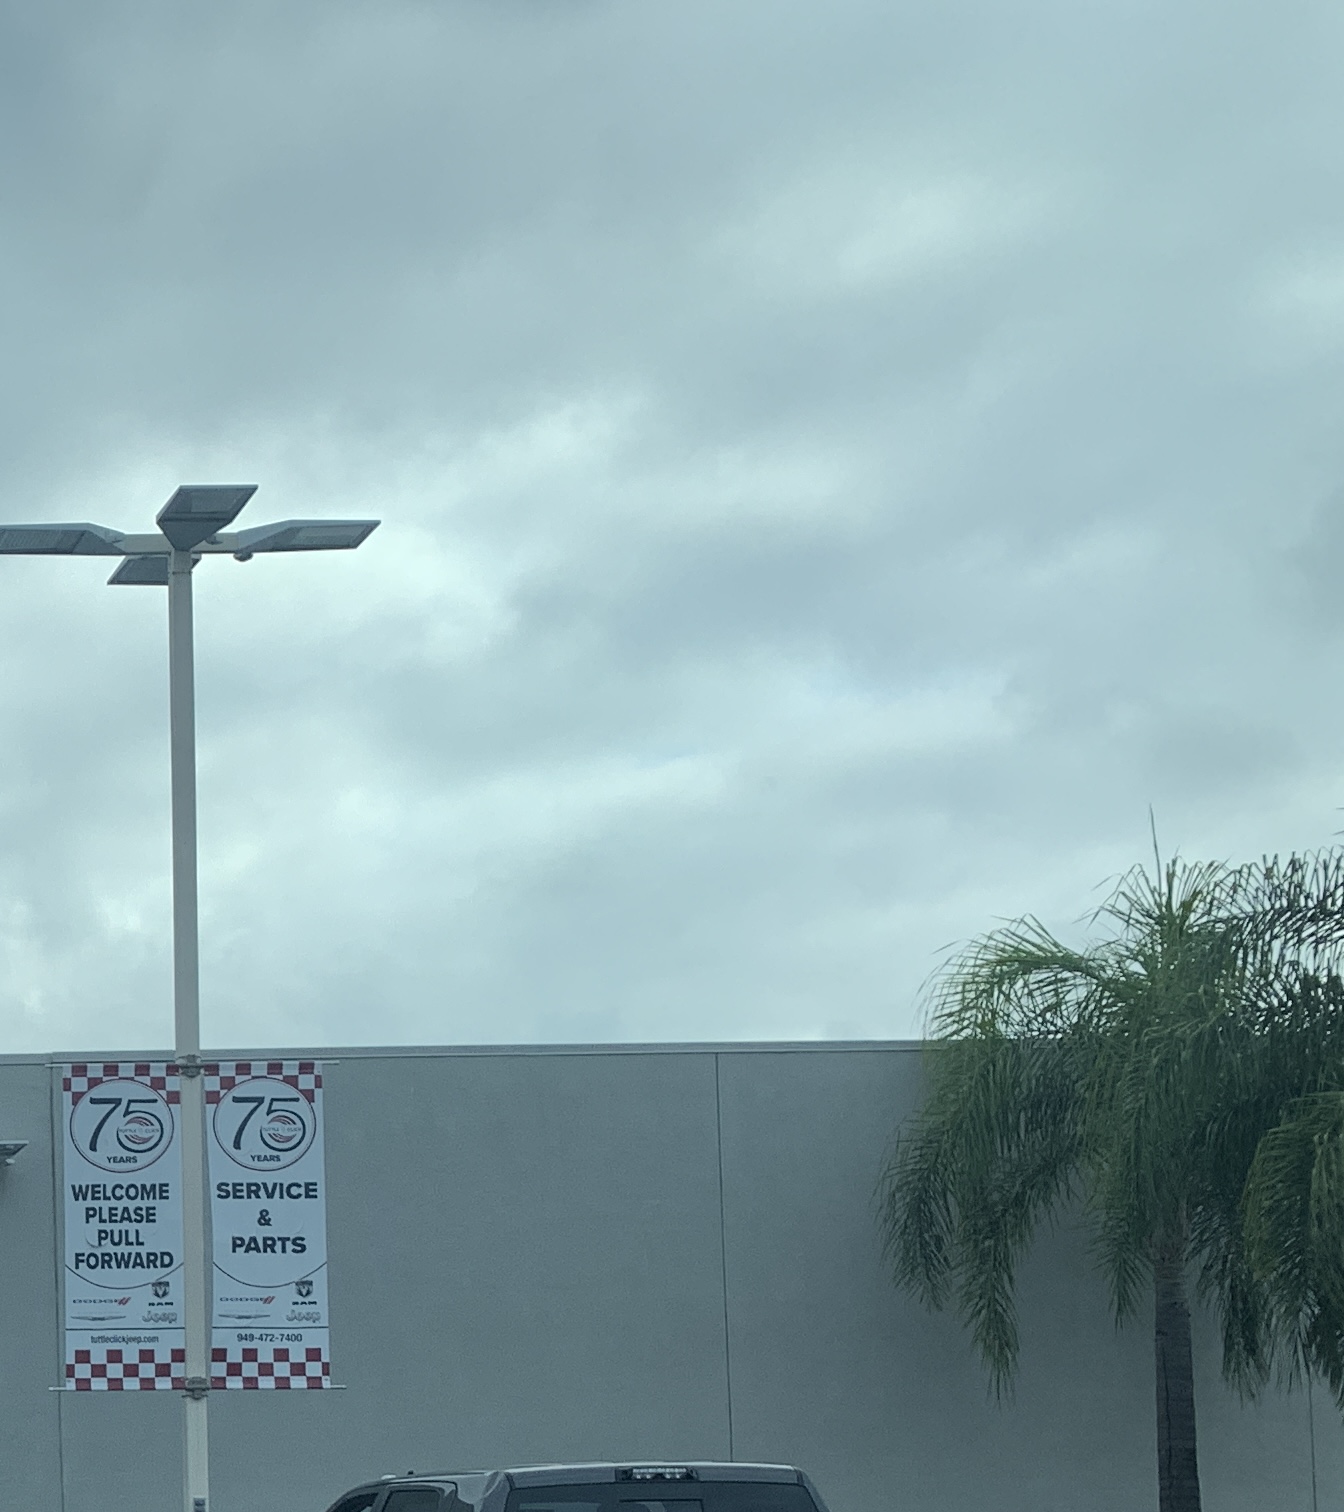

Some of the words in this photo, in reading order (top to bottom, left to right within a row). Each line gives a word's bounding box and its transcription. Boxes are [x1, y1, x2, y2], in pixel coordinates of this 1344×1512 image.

[89, 1097, 164, 1153] 75
[232, 1095, 306, 1152] 75
[107, 1156, 138, 1164] YEARS
[250, 1154, 281, 1162] YEARS
[70, 1183, 170, 1202] WELCOME
[216, 1182, 319, 1200] SERVICE
[85, 1206, 157, 1224] PLEASE
[257, 1208, 273, 1227] &
[97, 1228, 145, 1247] PULL
[231, 1236, 307, 1254] PARTS
[74, 1251, 174, 1270] FORWARD
[236, 1333, 303, 1342] 949-472-7400
